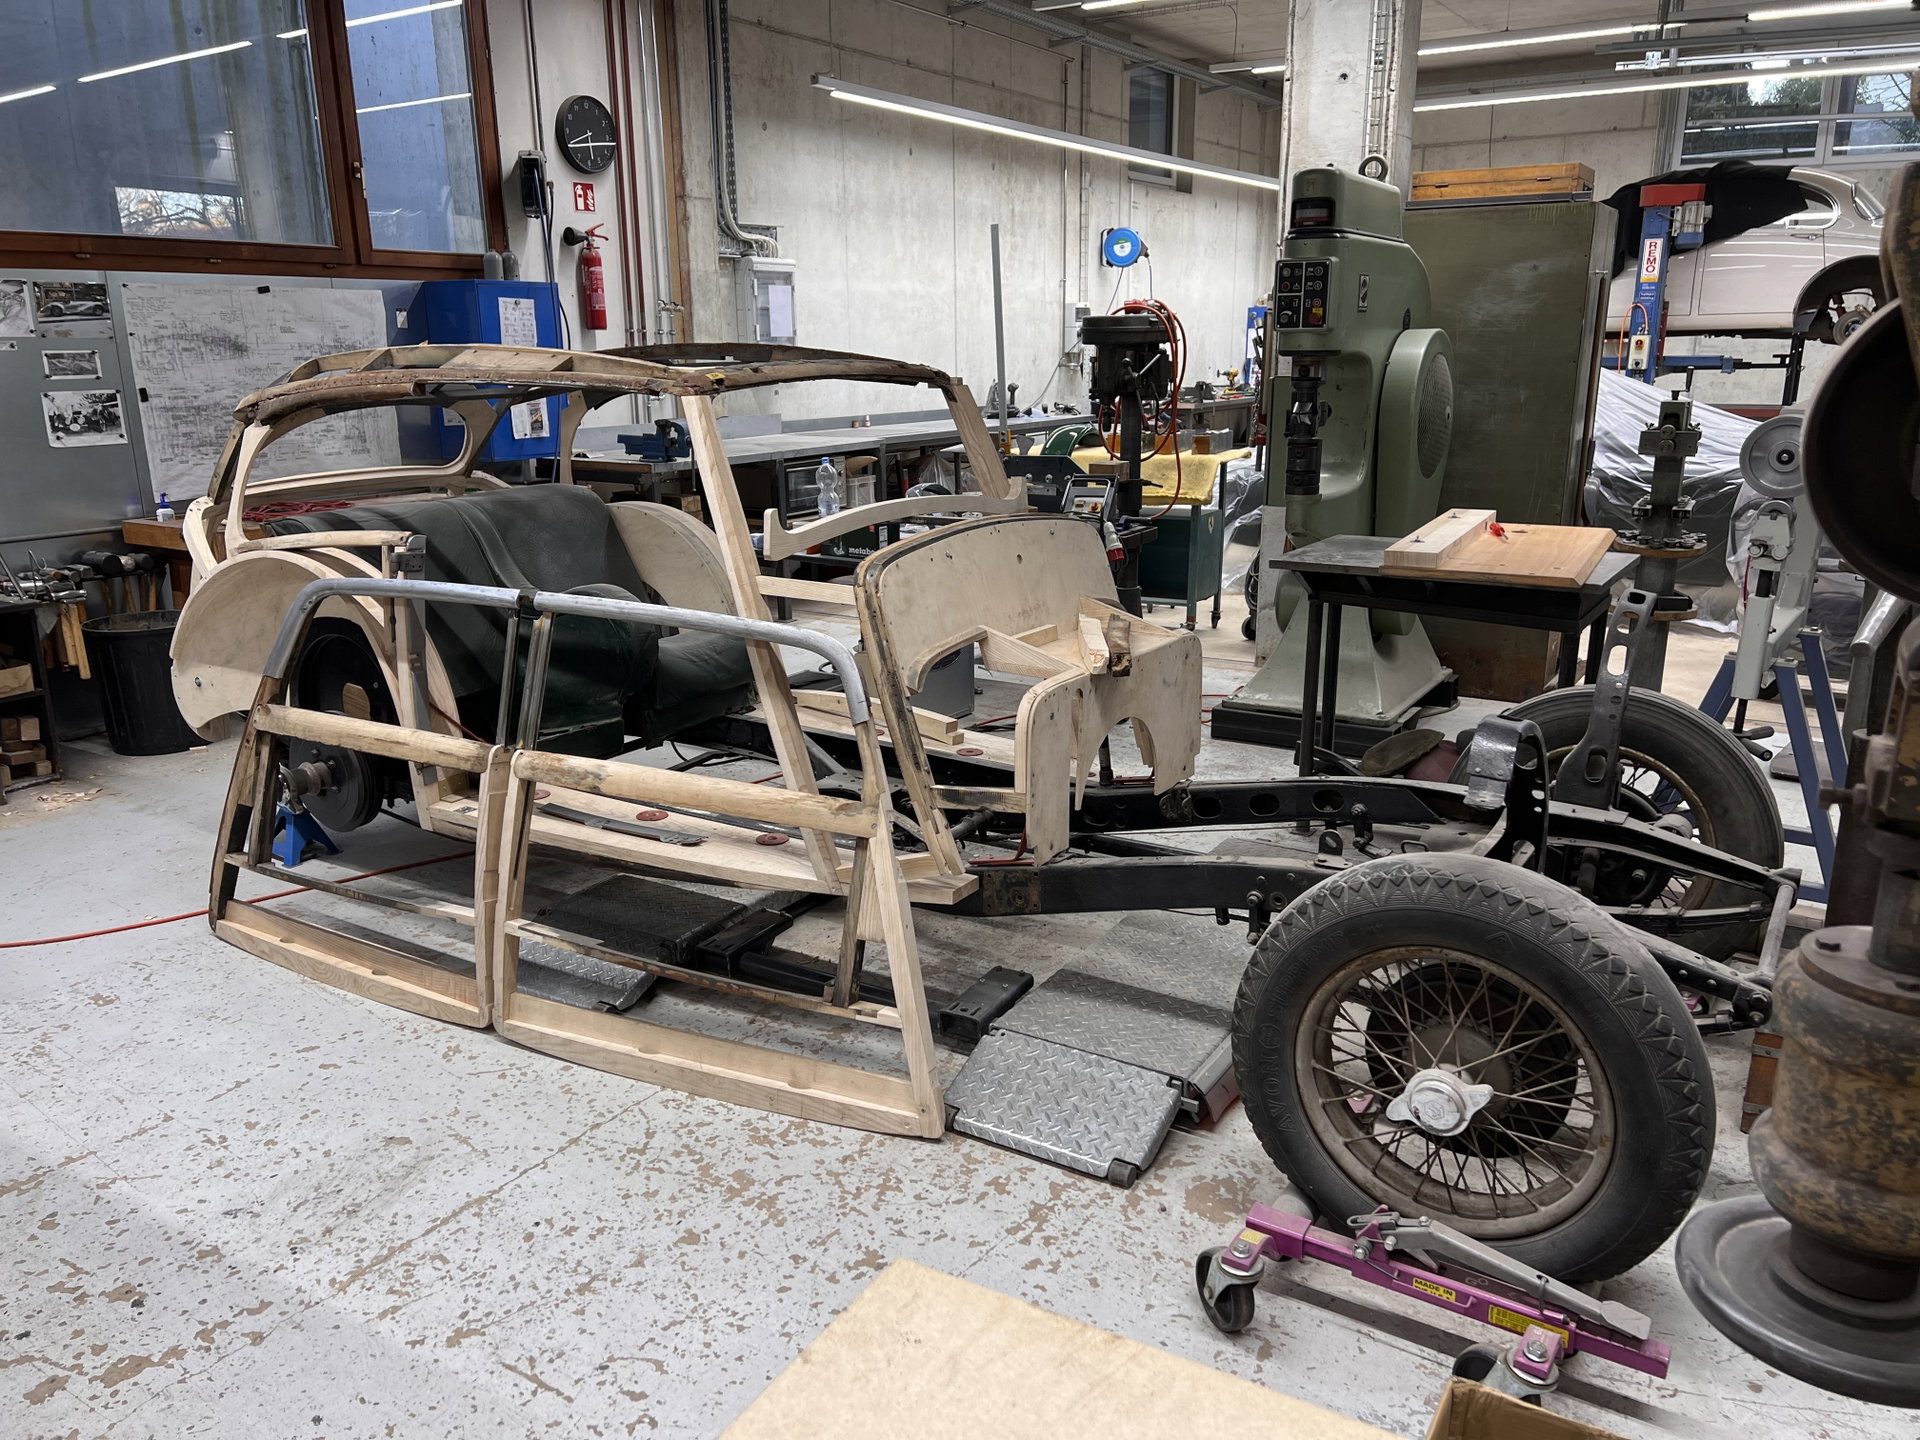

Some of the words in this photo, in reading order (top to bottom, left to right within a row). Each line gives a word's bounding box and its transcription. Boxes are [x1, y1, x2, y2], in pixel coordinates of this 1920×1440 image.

[1645, 241, 1658, 273] REMO
[1261, 1054, 1298, 1133] AVON
[1414, 1279, 1440, 1291] MADE
[1443, 1288, 1452, 1296] IN
